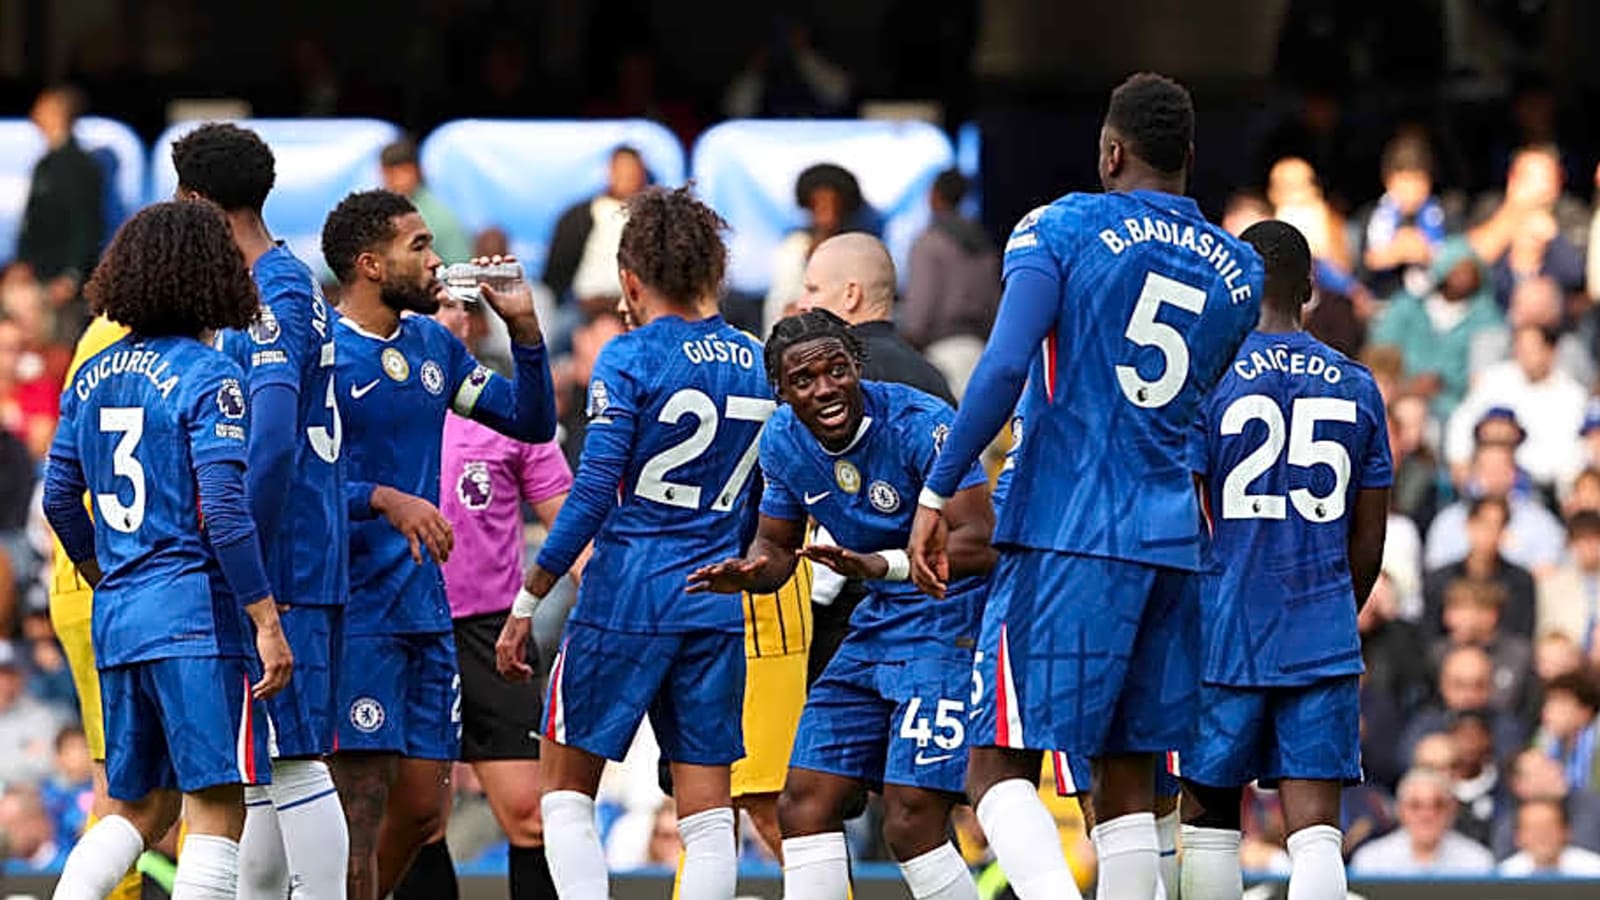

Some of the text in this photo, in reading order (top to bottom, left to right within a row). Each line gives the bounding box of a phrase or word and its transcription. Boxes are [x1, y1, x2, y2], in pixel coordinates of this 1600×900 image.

[1098, 216, 1252, 305] B.BADIASHILE
[75, 349, 179, 402] CUCURELLA
[682, 339, 754, 370] GUSTO
[1115, 271, 1207, 409] 5
[1233, 348, 1343, 385] CAICEDO
[97, 407, 145, 533] 3
[633, 387, 777, 512] 27
[1220, 392, 1358, 523] 25
[900, 697, 965, 750] 45
